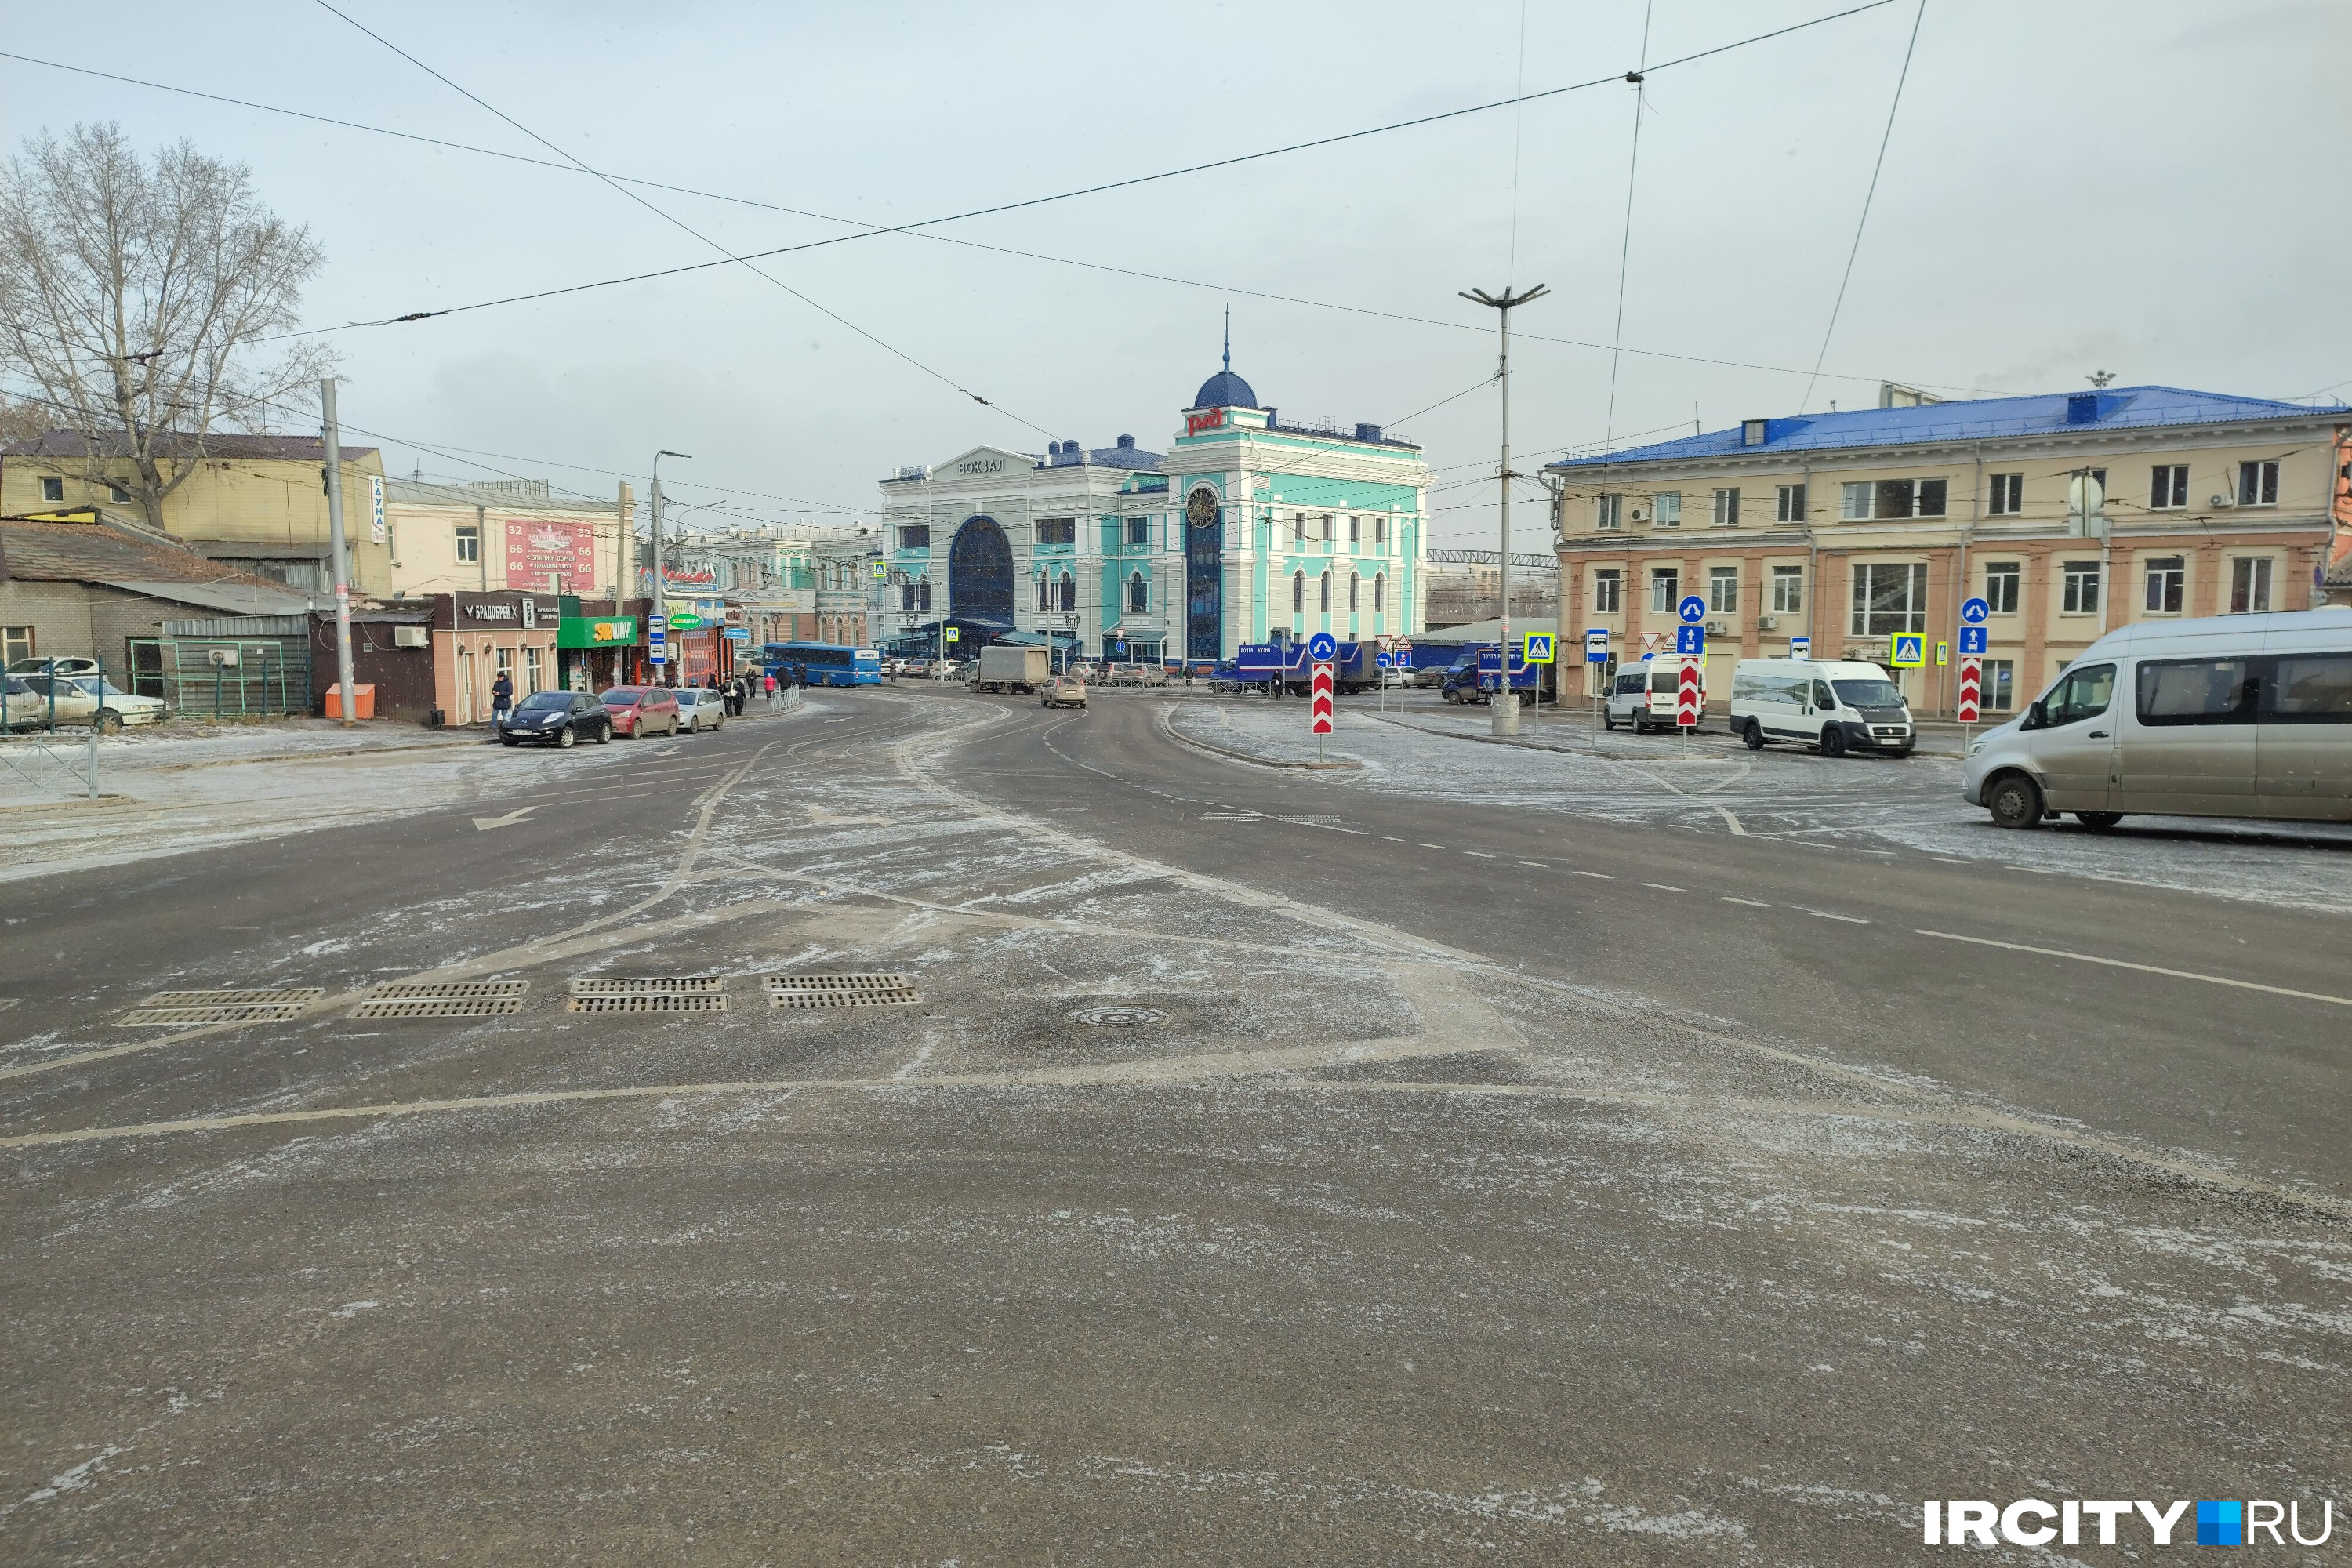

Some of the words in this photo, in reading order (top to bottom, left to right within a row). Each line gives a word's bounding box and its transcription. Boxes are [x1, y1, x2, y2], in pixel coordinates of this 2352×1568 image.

[958, 459, 1005, 474] ВОКЗАЛ
[375, 478, 383, 525] САУНА
[508, 525, 523, 535] 32
[577, 528, 591, 538] 32
[509, 544, 524, 554] 66
[578, 547, 592, 556] 66
[509, 561, 524, 571] 66
[578, 564, 592, 573] 66
[475, 603, 510, 621] БРАДОБРЕЙ
[593, 621, 632, 642] SUBWAY
